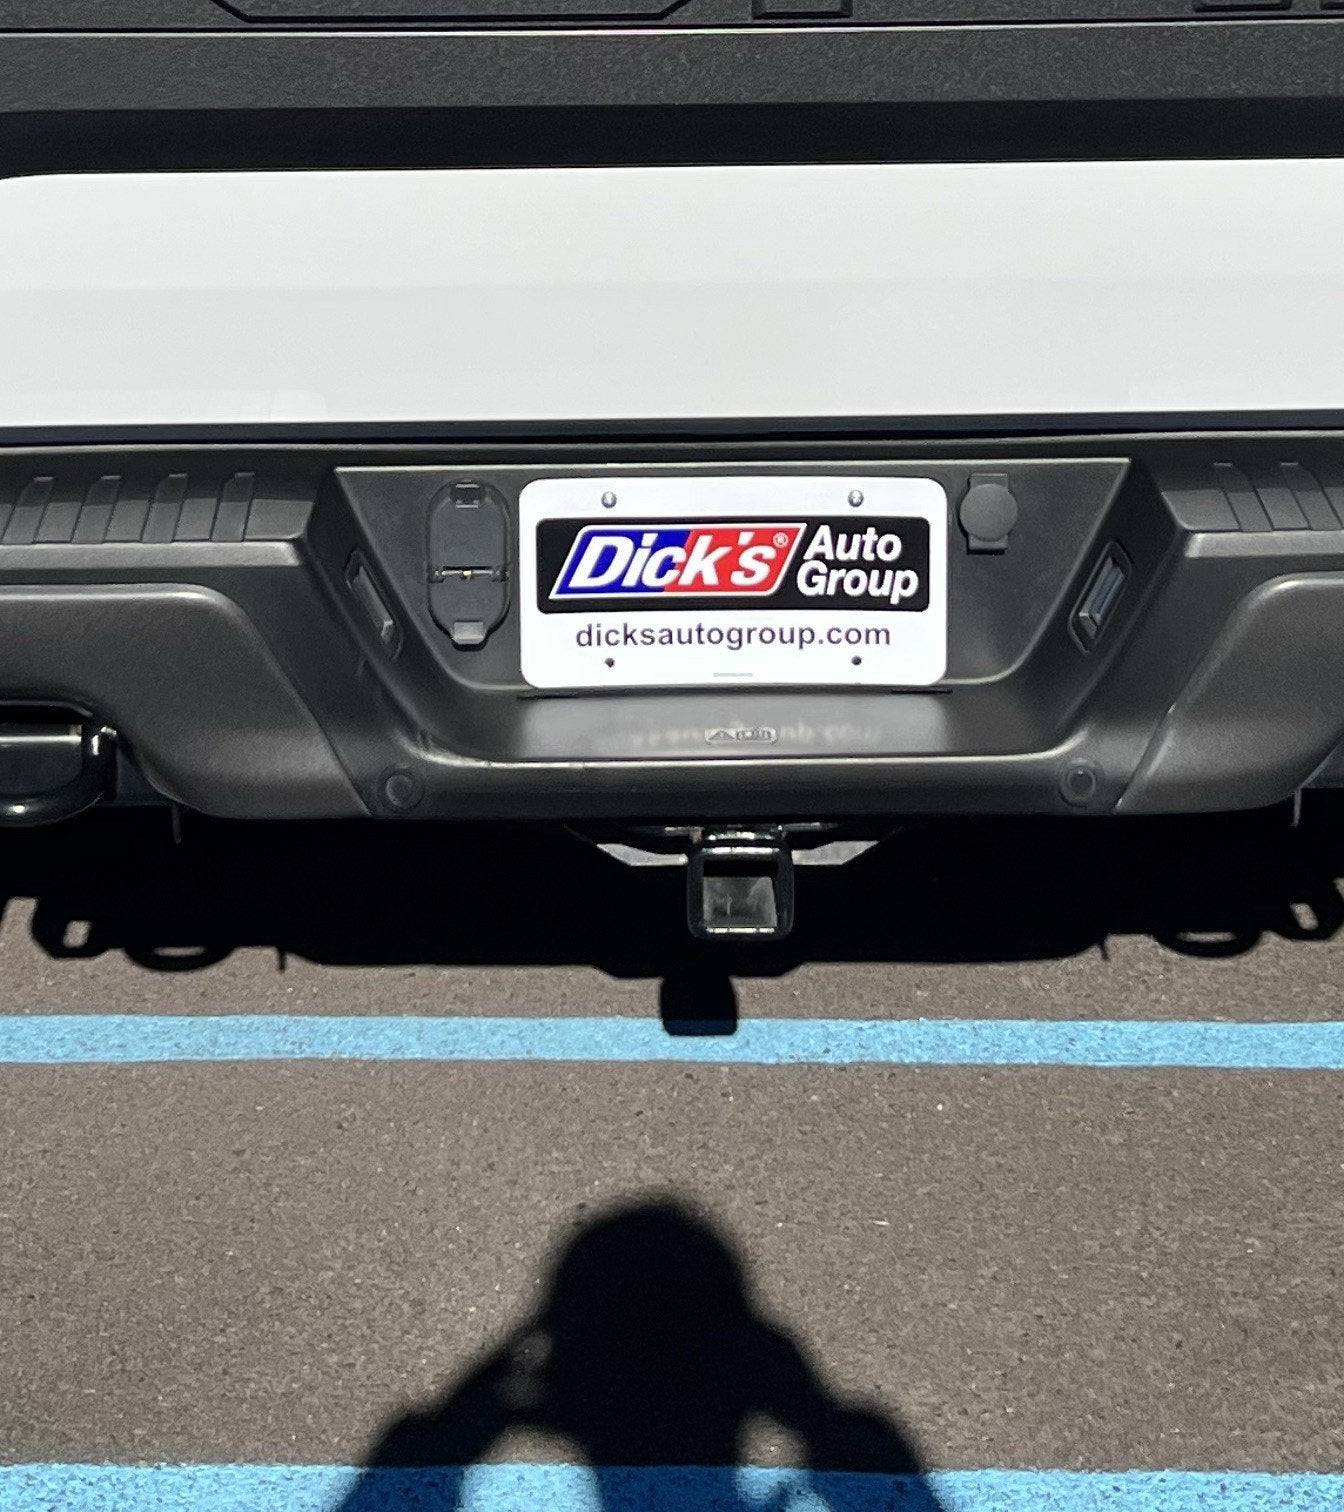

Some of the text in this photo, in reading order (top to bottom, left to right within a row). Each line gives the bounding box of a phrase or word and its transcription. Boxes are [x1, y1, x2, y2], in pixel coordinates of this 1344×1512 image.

[568, 530, 778, 588] Dick's
[803, 524, 902, 562] Auto
[796, 559, 919, 605] Group
[576, 622, 891, 651] dicksautogroup.com
